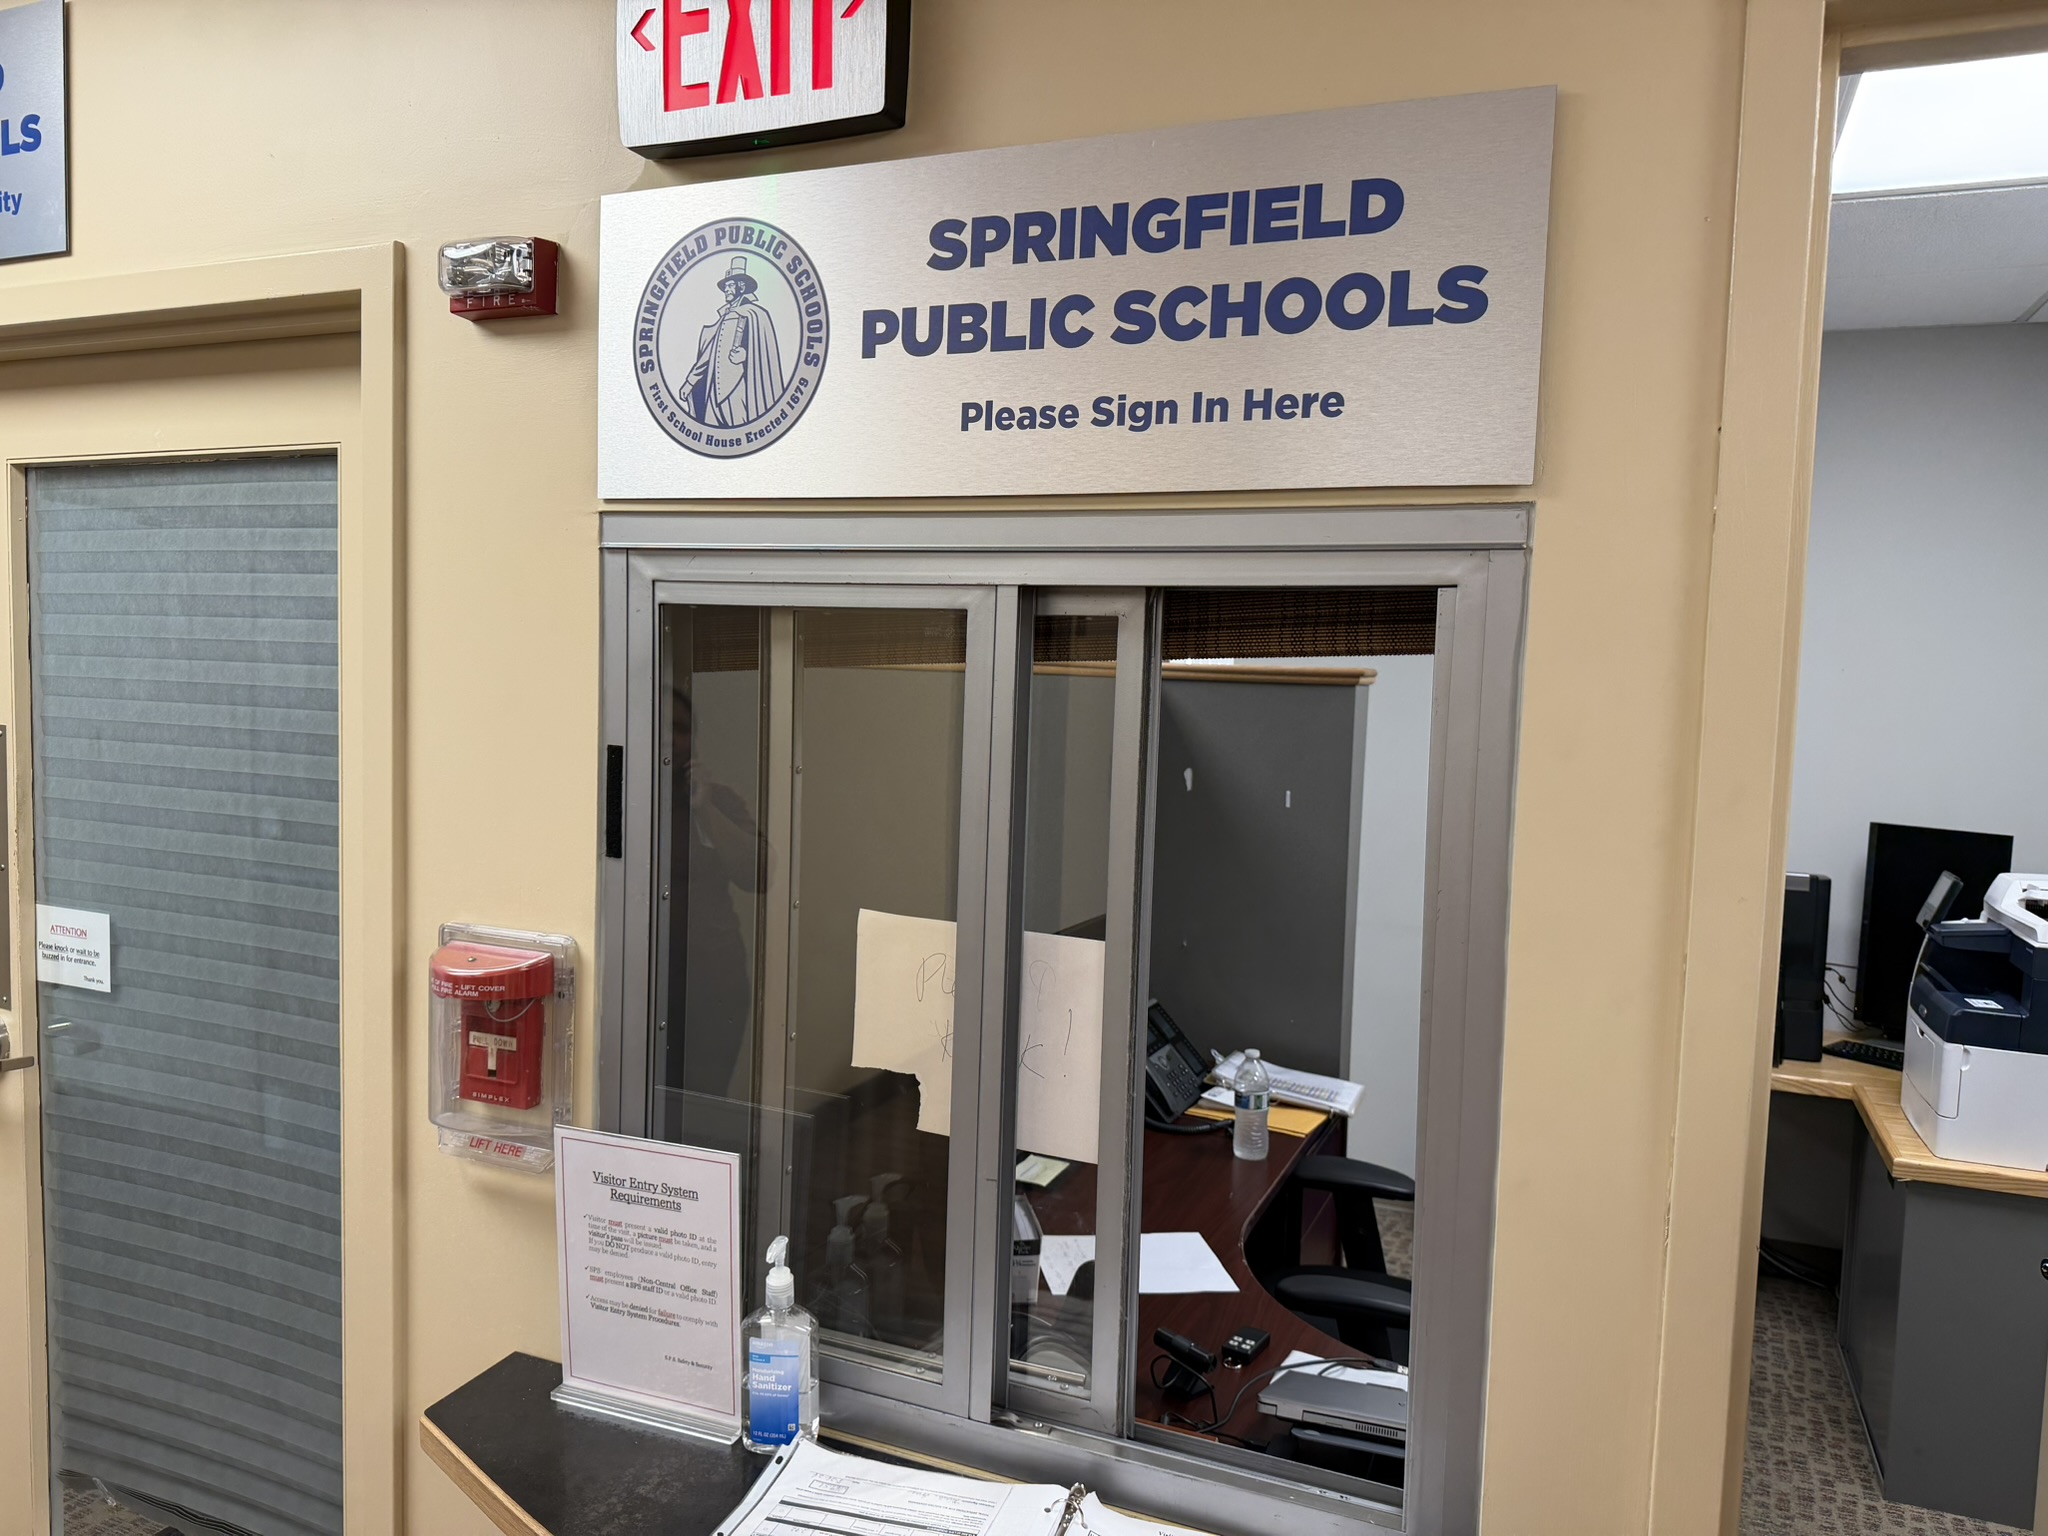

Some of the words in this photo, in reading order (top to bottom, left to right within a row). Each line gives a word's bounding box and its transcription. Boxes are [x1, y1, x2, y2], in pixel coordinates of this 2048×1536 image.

[926, 178, 1405, 271] SPRINGFIELD
[466, 293, 516, 309] FIRE
[639, 234, 708, 374] SPRINGFIELD
[714, 225, 788, 260] PUBLIC
[785, 255, 823, 368] SCHOOLS
[861, 294, 1096, 359] PUBLIC
[1109, 265, 1489, 345] SCHOOLS
[649, 382, 669, 414] First
[667, 410, 702, 443] School
[705, 434, 742, 448] House
[745, 409, 789, 439] Erected
[788, 376, 810, 411] 1679
[960, 400, 1080, 432] Please
[1090, 394, 1178, 433] Sign
[1192, 391, 1229, 424] In
[1243, 388, 1345, 421] Here
[50, 924, 87, 938] ATTENTION
[39, 941, 53, 950] Please
[54, 943, 69, 953] knock
[76, 948, 87, 956] wait
[42, 951, 59, 961] buzzed
[454, 989, 479, 997] ALARM
[460, 983, 476, 991] LIFT
[472, 1091, 511, 1103] SIMPLEX
[469, 1136, 493, 1151] LIFT
[493, 1142, 523, 1158] HERE
[592, 1170, 627, 1188] Visitor
[628, 1177, 659, 1195] Entry
[661, 1182, 699, 1201] System
[610, 1188, 682, 1213] Requirements
[637, 1232, 657, 1242] picture
[653, 1226, 668, 1235] valid
[670, 1229, 687, 1239] photo
[689, 1232, 698, 1241] ID
[605, 1240, 616, 1248] DO
[615, 1242, 630, 1251] NOT
[673, 1253, 690, 1263] photo
[701, 1260, 718, 1270] entry
[609, 1306, 626, 1317] Entry
[626, 1309, 648, 1320] System
[629, 1302, 648, 1313] denied
[752, 1372, 776, 1382] Hand
[752, 1381, 792, 1391] Sanitizer
